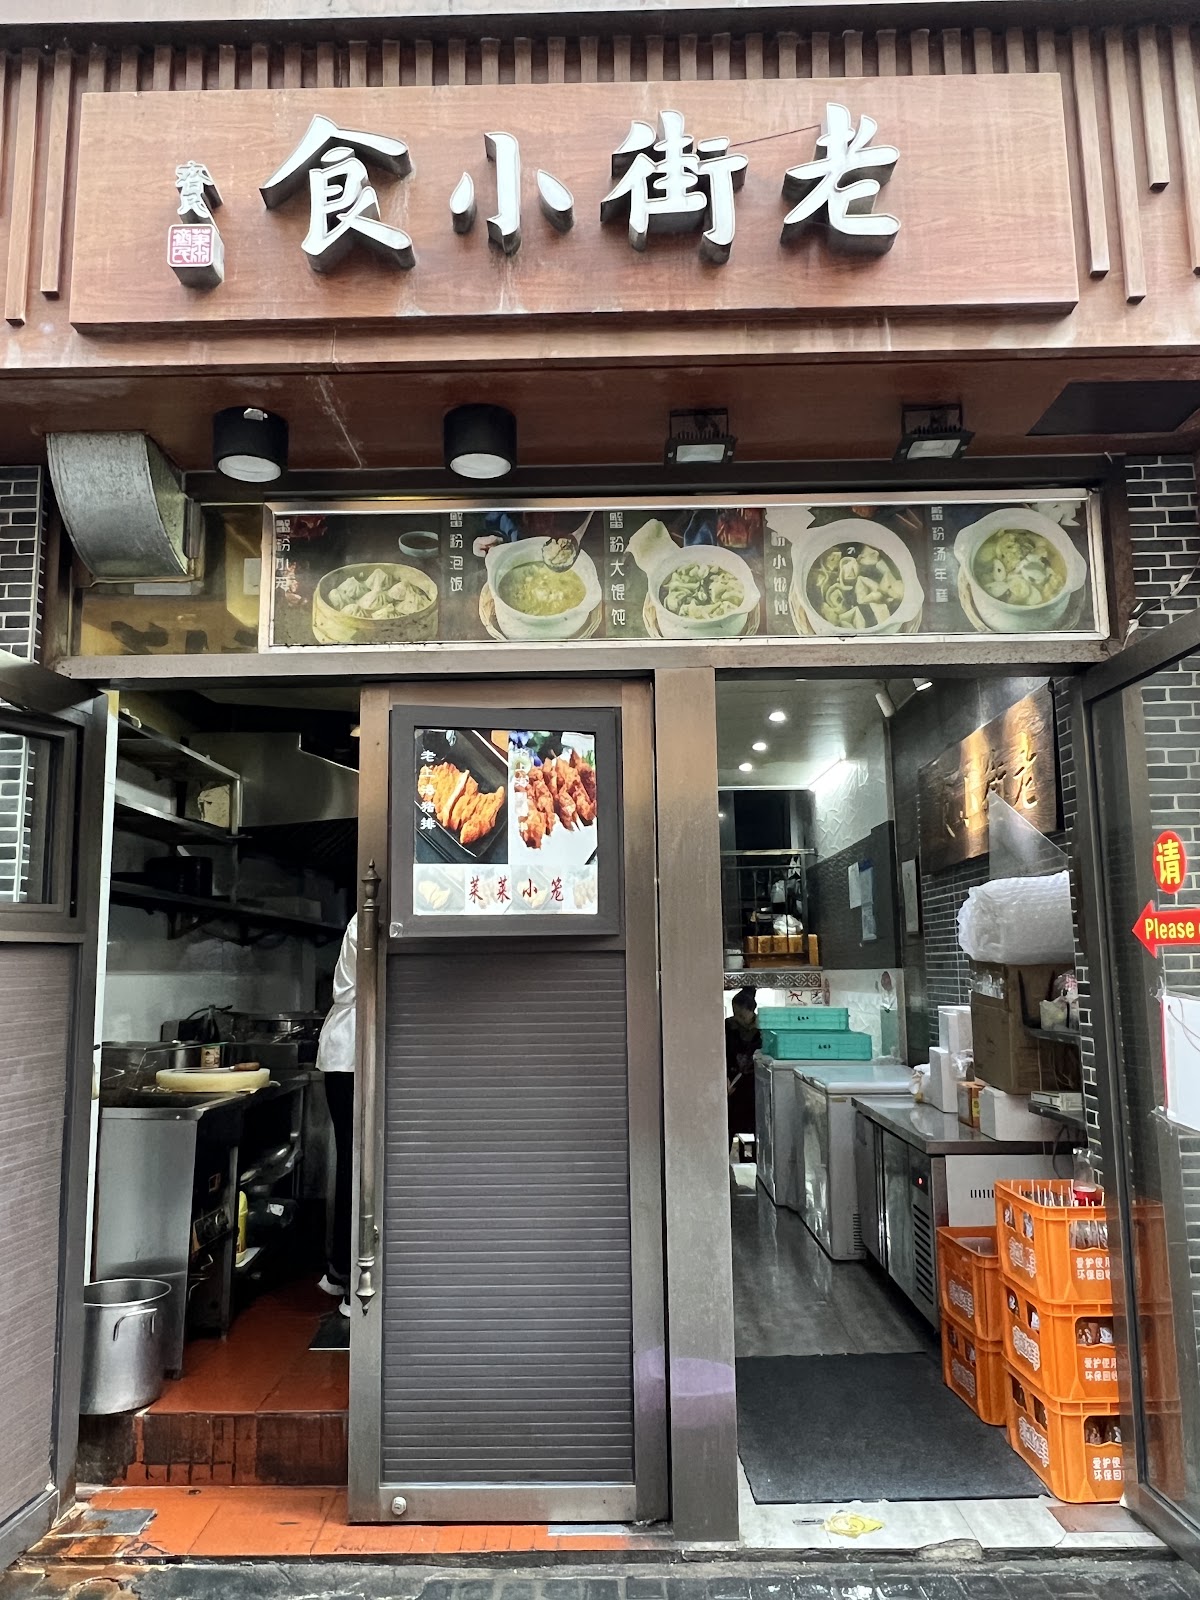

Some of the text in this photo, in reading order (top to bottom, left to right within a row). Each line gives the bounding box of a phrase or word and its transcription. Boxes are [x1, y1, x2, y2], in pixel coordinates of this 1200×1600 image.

[449, 512, 464, 592] 蟹粉泡饭
[609, 511, 626, 626] 蟹粉大馄饨
[1155, 838, 1181, 885] 请
[1144, 918, 1195, 940] Please
[1093, 1469, 1125, 1482] 环保回
